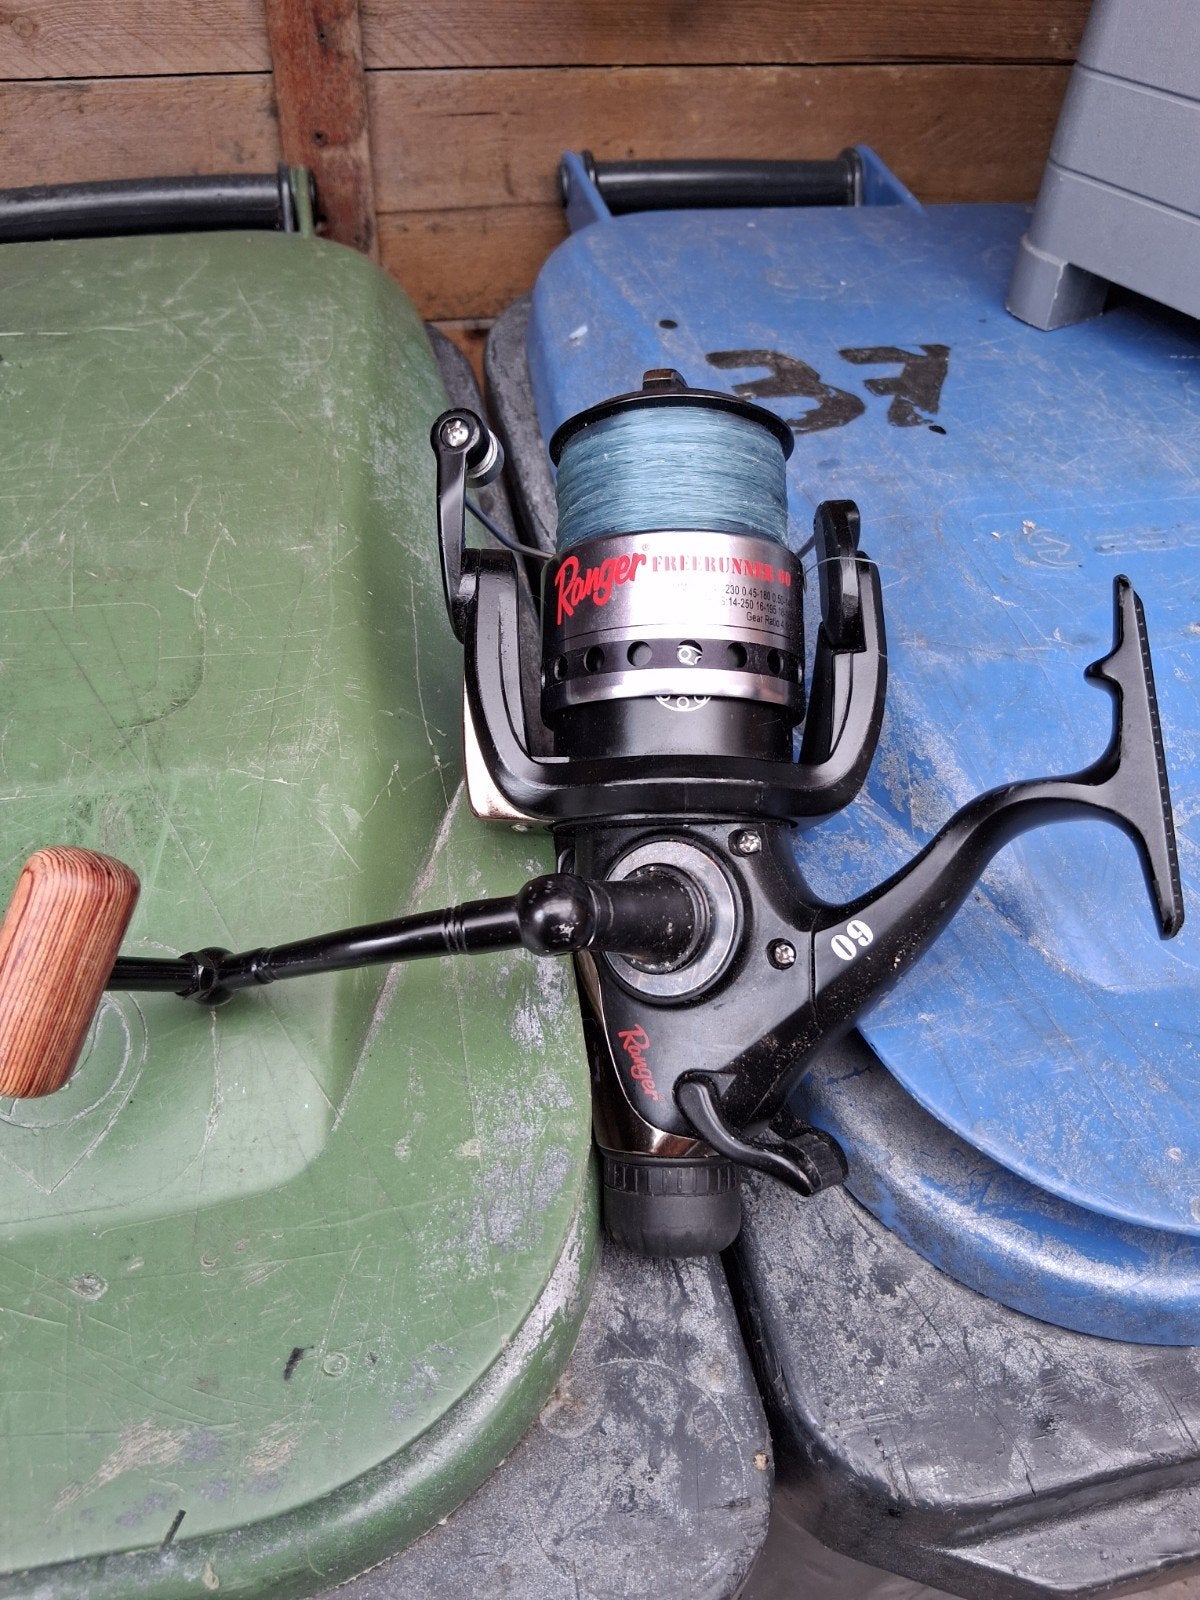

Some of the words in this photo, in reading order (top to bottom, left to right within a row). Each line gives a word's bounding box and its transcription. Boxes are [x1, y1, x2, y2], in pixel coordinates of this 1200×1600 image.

[554, 552, 647, 626] Ranger
[652, 555, 773, 583] FREERUNNER
[746, 611, 763, 623] Gear
[765, 615, 780, 628] Ratio
[618, 1024, 660, 1101] Ranger
